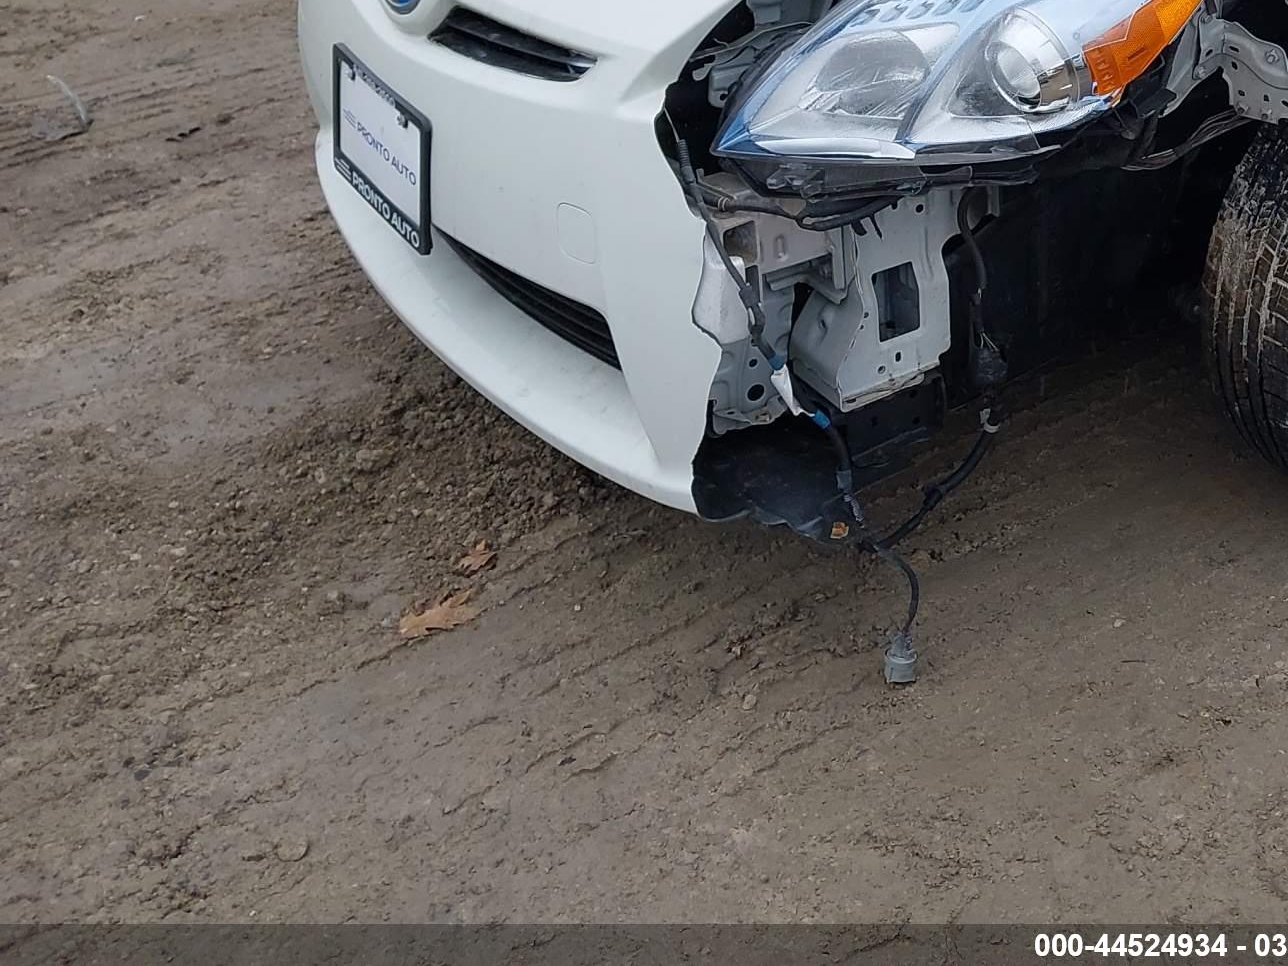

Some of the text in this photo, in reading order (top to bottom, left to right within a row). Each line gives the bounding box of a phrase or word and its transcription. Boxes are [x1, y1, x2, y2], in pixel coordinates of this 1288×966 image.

[356, 121, 417, 186] PRONTO AUTO
[350, 169, 420, 249] PRONTO AUTO
